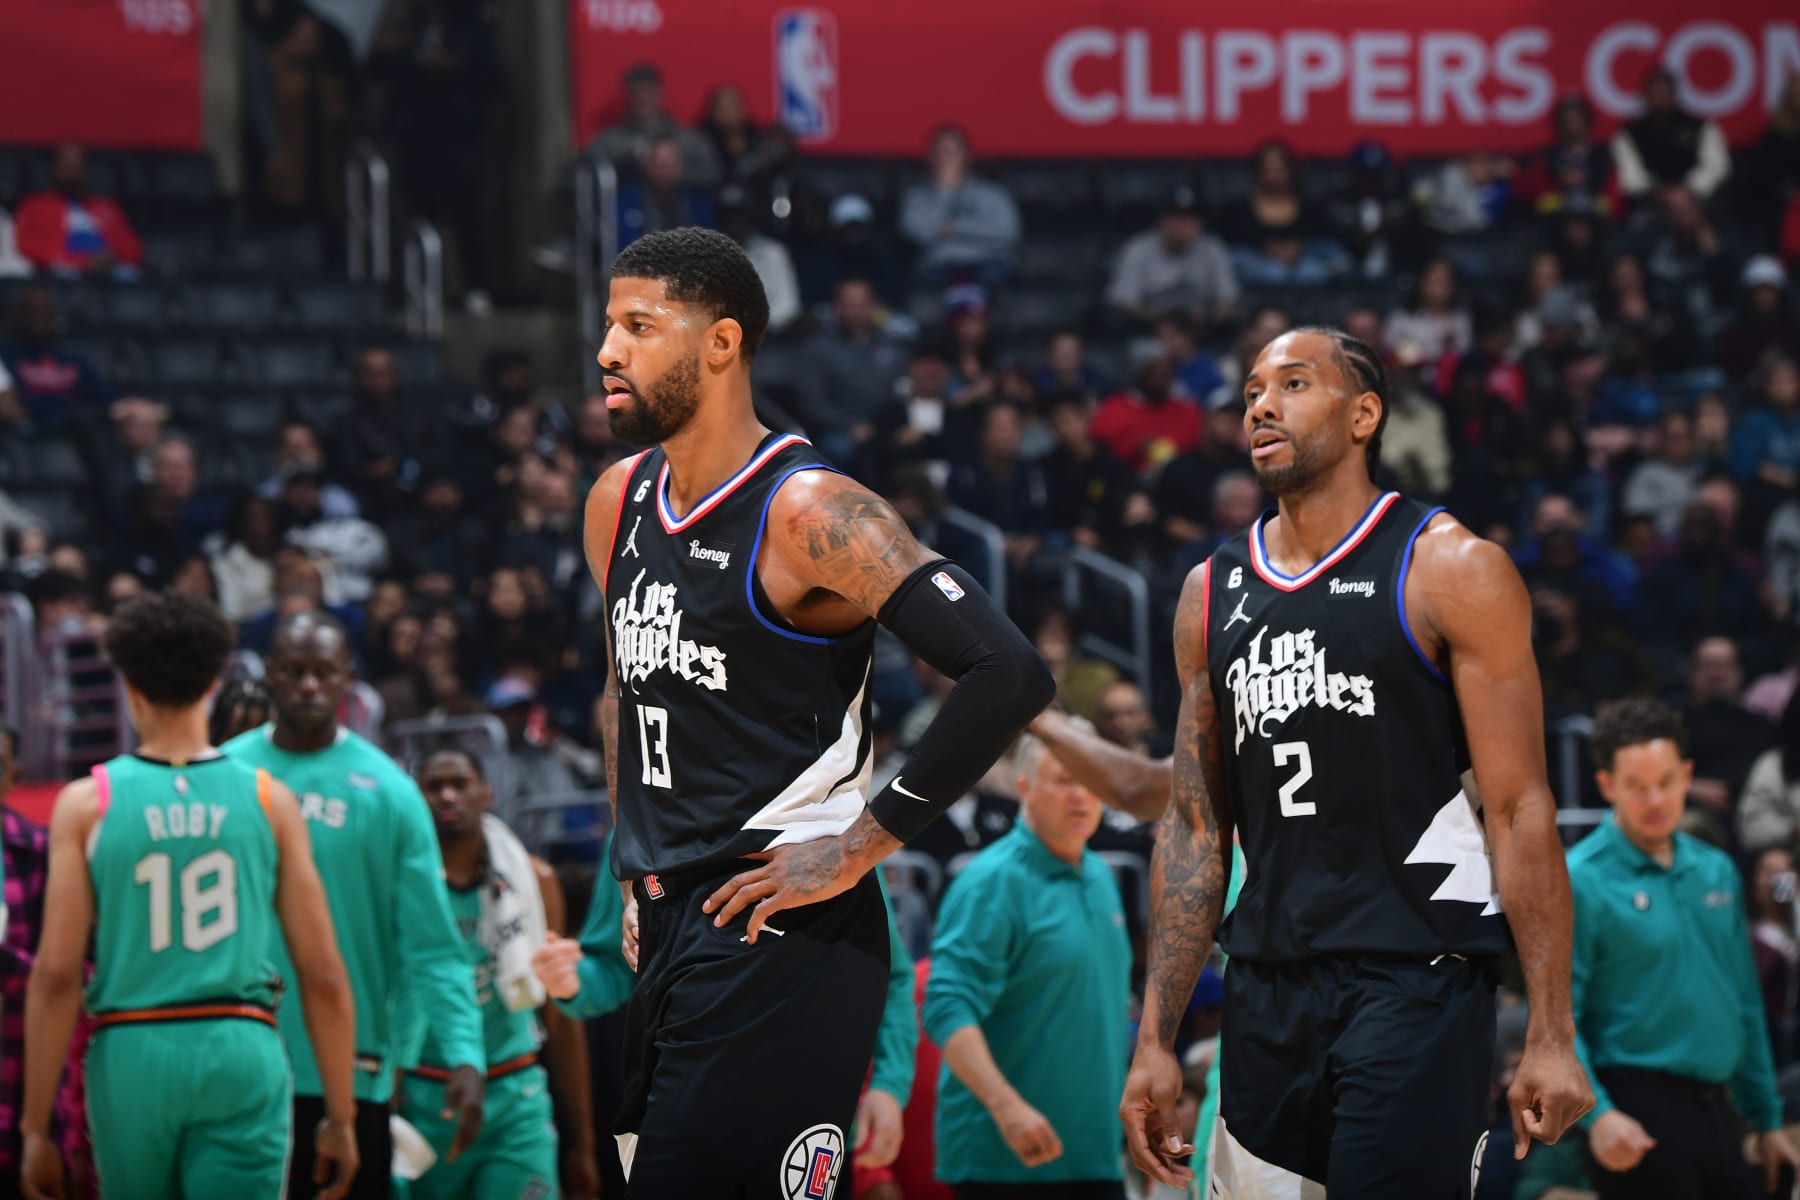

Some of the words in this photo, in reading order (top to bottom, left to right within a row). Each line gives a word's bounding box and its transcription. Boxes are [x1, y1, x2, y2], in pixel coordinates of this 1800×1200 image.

[634, 480, 651, 502] 6
[689, 539, 730, 570] honey
[1228, 567, 1243, 588] 6
[624, 568, 678, 629] Los
[1329, 577, 1375, 597] honey
[612, 597, 727, 697] Angeles
[1246, 625, 1316, 681] Los
[1226, 647, 1375, 756] Angeles
[636, 704, 672, 789] 13
[1272, 741, 1316, 817] 2
[144, 802, 229, 841] ROBY
[134, 848, 238, 954] 18
